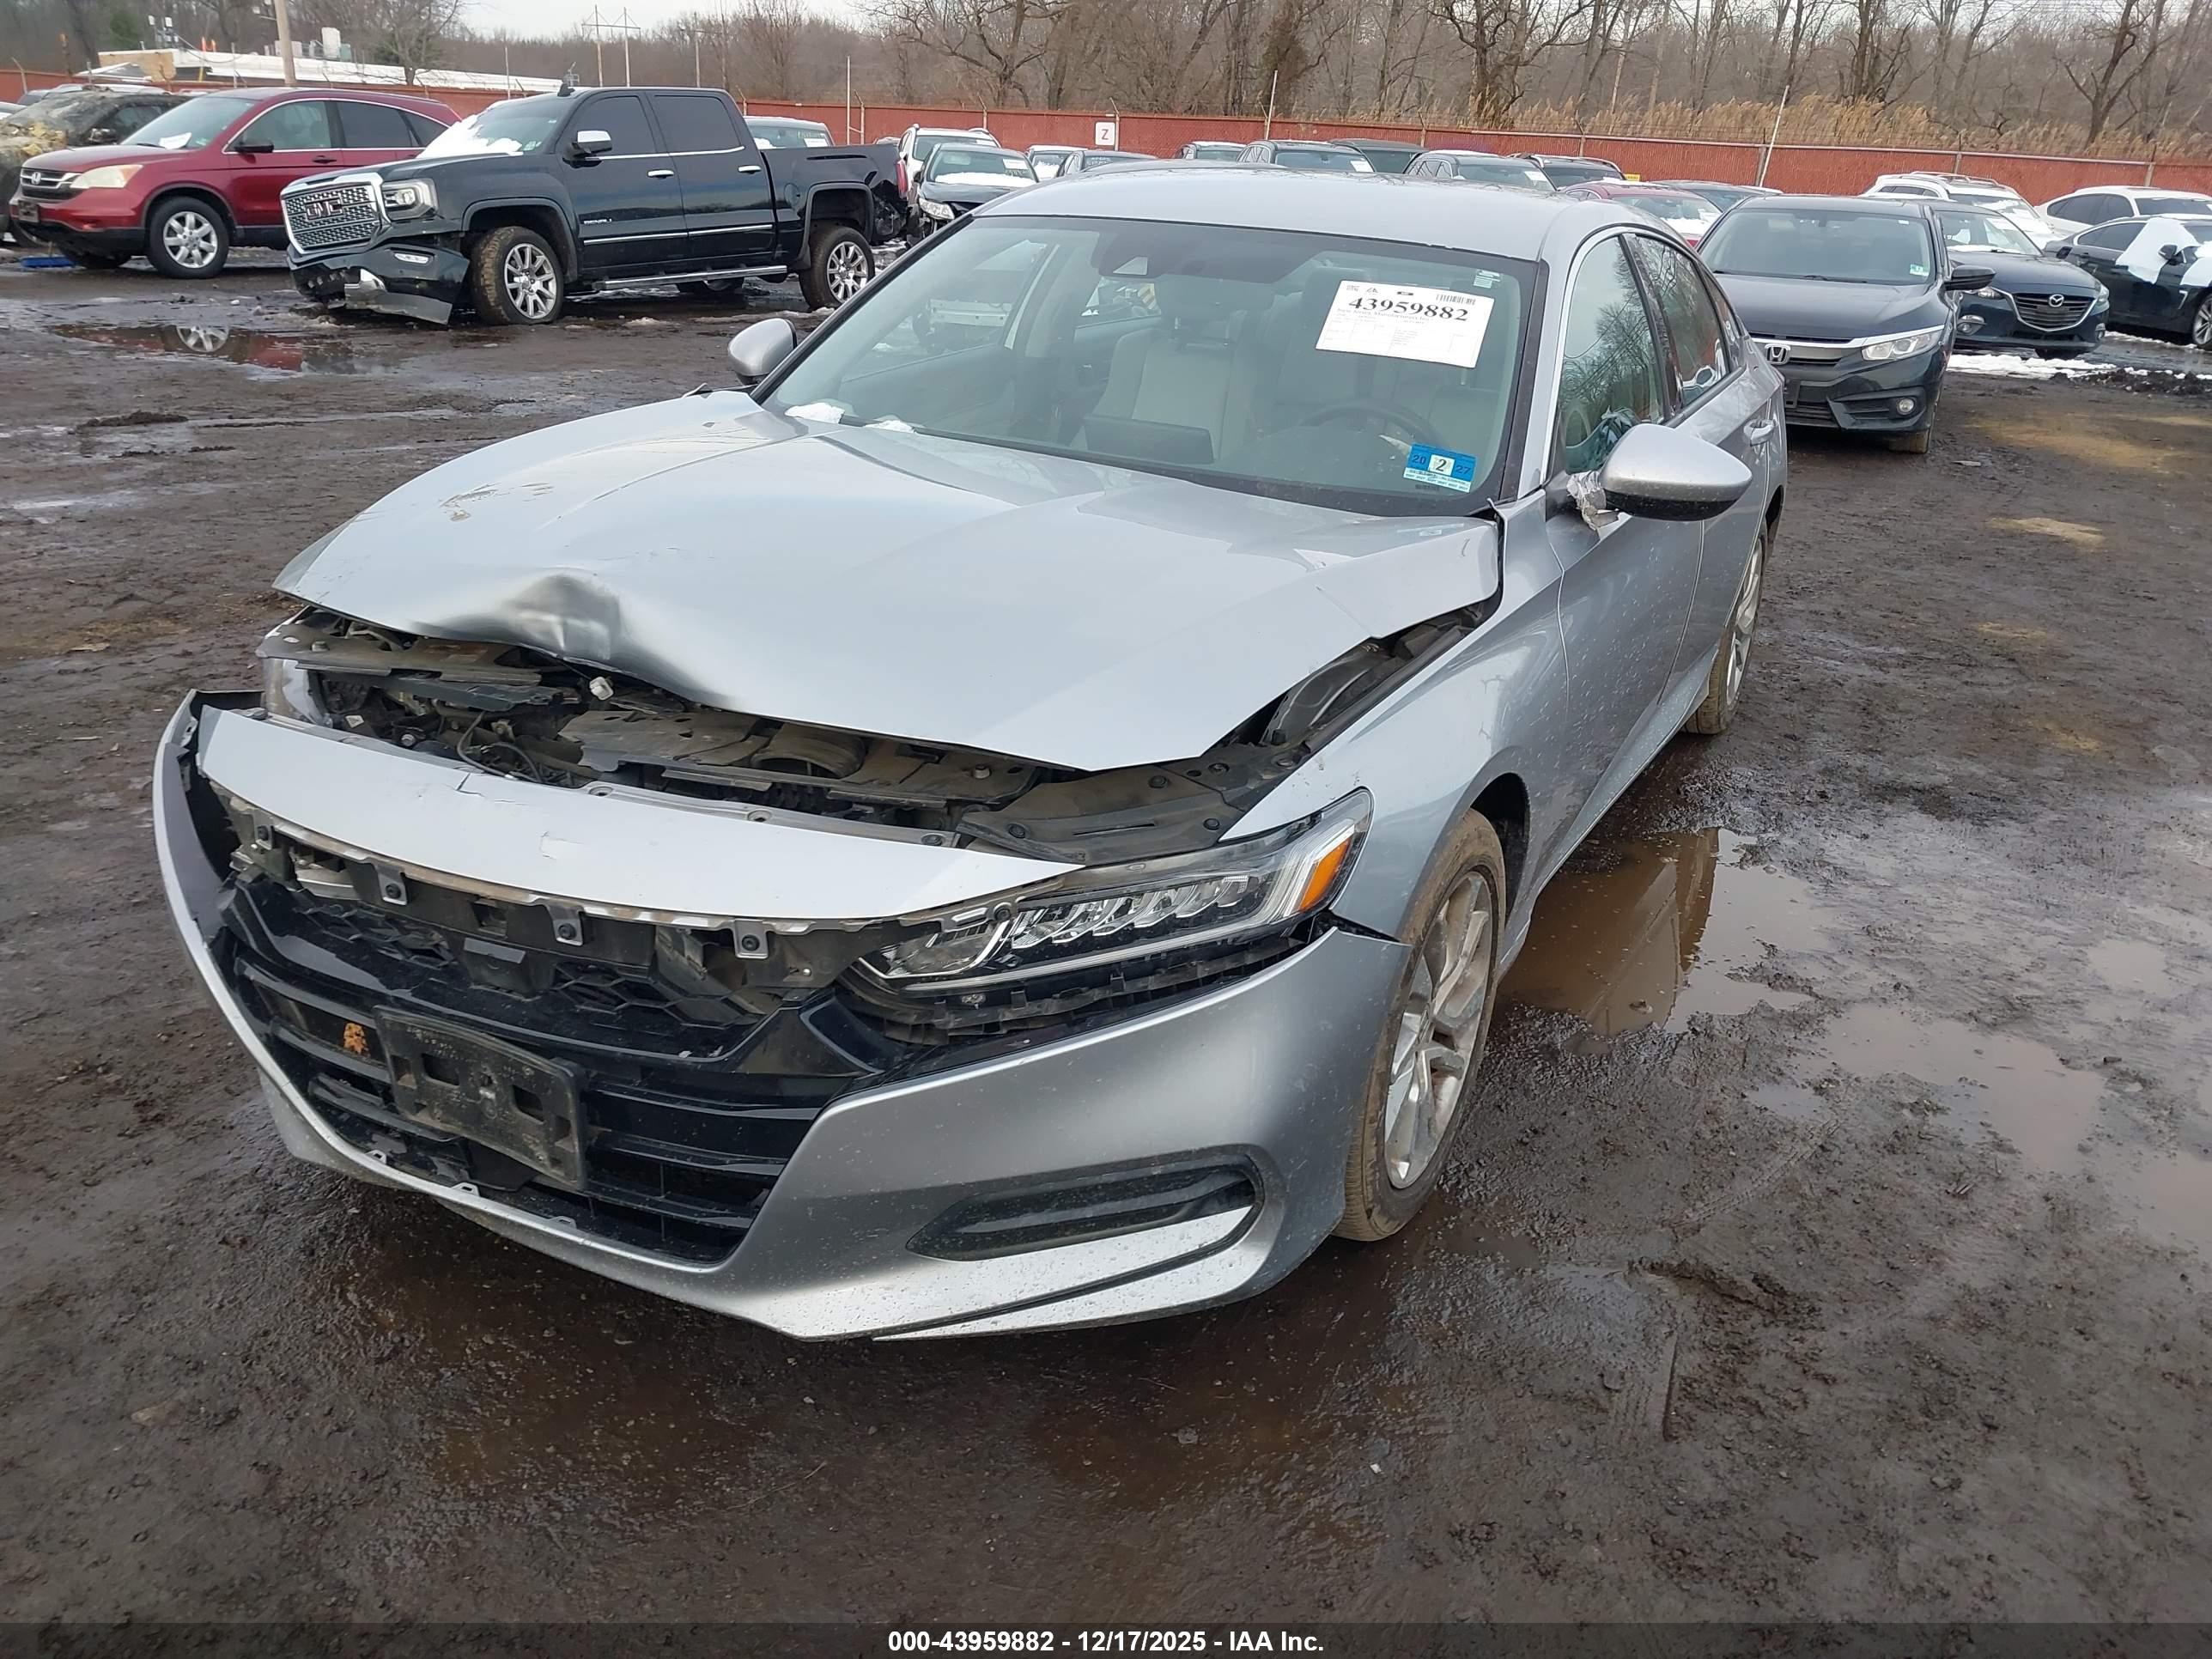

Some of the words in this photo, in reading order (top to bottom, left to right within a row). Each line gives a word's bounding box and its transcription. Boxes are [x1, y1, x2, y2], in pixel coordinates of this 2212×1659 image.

[306, 199, 343, 219] GMC
[1348, 296, 1468, 321] 43959882
[1413, 454, 1425, 465] 20
[1436, 459, 1447, 472] 2
[1455, 465, 1471, 475] 27
